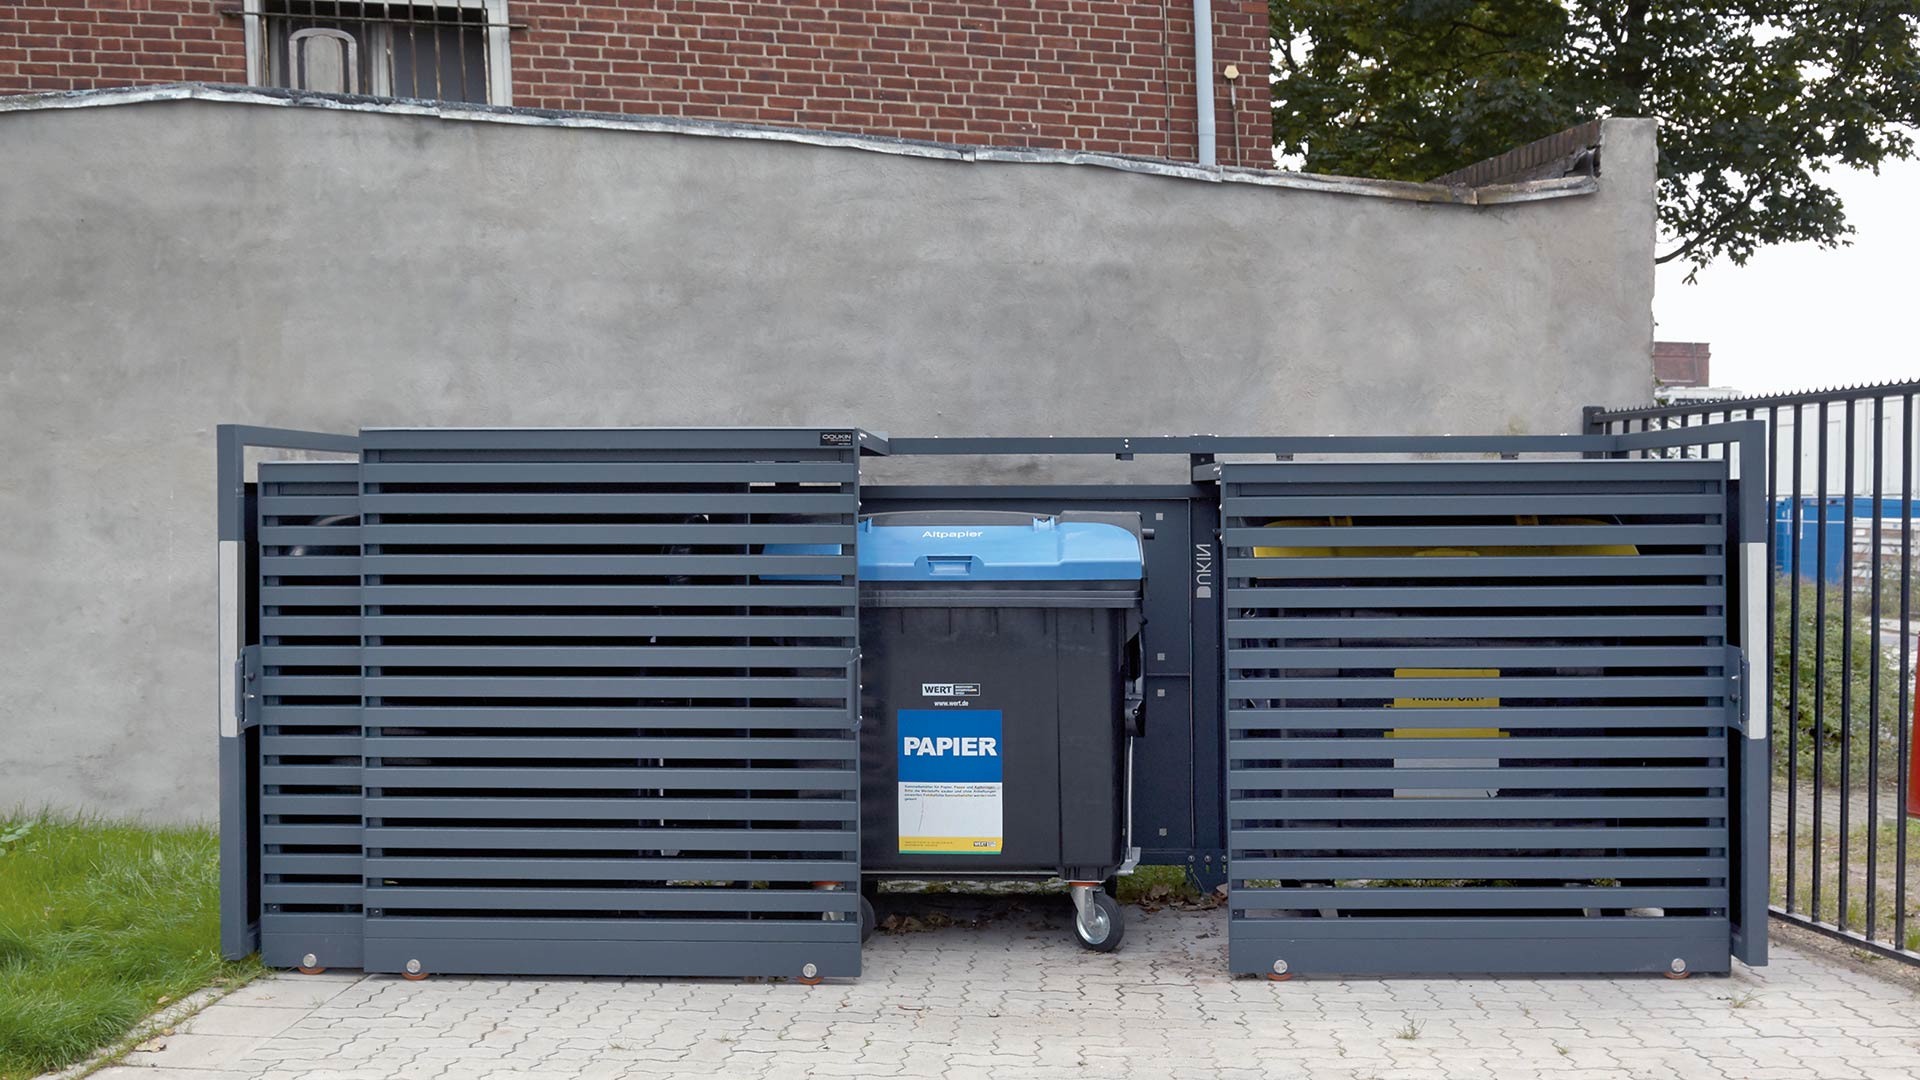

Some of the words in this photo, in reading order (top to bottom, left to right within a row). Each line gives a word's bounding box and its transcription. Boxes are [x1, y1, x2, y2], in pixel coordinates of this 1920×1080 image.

[922, 530, 983, 539] Altpapier
[924, 686, 952, 694] WERT
[904, 736, 998, 756] PAPIER
